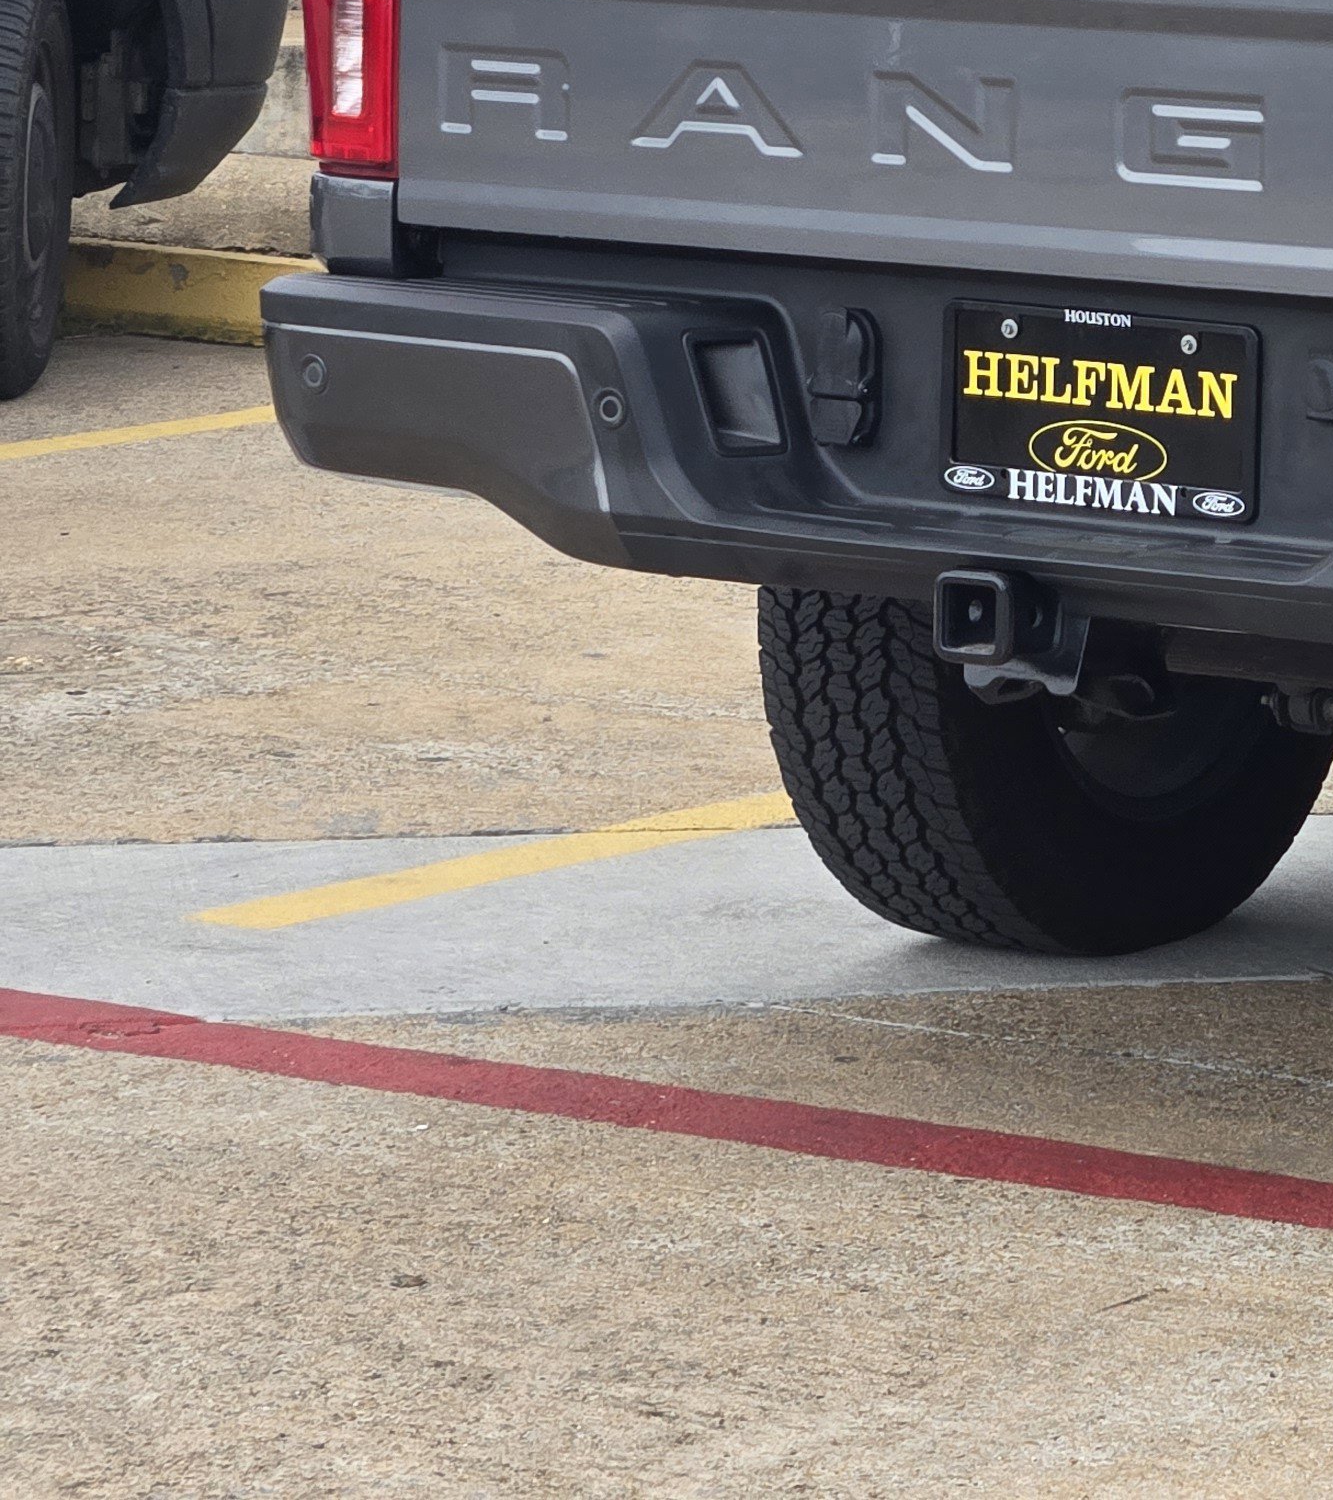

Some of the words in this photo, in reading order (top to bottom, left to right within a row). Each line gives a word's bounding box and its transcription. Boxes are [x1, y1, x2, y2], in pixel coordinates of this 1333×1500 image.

[1064, 308, 1132, 328] HOUSTON
[963, 349, 1238, 419] HELFMAN
[1054, 426, 1139, 474] Ford
[952, 468, 986, 487] Ford
[1007, 467, 1179, 517] HELFMAN
[1202, 494, 1236, 513] Ford
